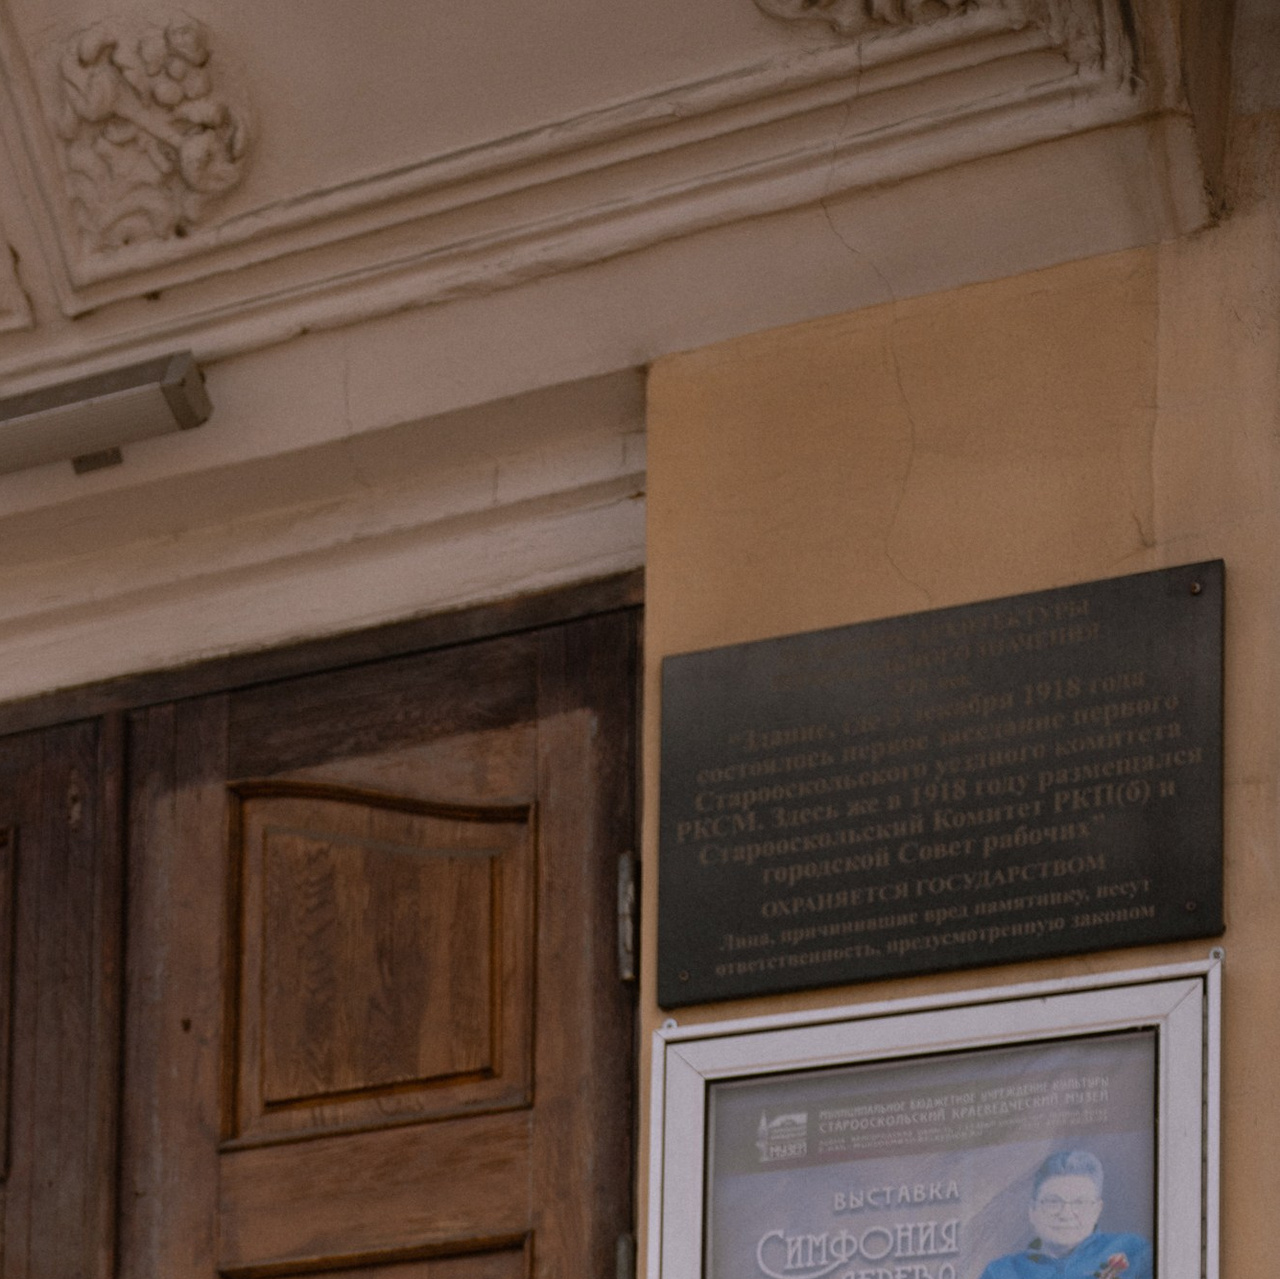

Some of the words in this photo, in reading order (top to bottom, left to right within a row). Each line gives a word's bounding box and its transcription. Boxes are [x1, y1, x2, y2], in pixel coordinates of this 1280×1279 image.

[915, 691, 1014, 724] декабря
[1023, 674, 1082, 706] 1918
[1089, 670, 1146, 696] года
[693, 762, 928, 813] Старооскольского
[934, 742, 1046, 783] уездного
[1055, 721, 1182, 758] комитета
[695, 750, 835, 787] состоялось
[841, 734, 930, 765] первое
[937, 712, 1066, 748] заседание
[1073, 693, 1180, 728] первого
[675, 810, 765, 845] РКСМ.
[771, 804, 840, 830] Здесь
[846, 795, 881, 818] же
[886, 793, 902, 811] в
[911, 777, 968, 808] 1918
[975, 771, 1030, 799] году
[1038, 746, 1204, 794] размещался
[697, 812, 925, 867] Старооскольский
[932, 799, 1044, 833] Комитет
[1053, 778, 1152, 814] РКП(б)
[1158, 779, 1177, 799] и
[760, 879, 910, 919] ОХРАНЯЕТСЯ
[915, 852, 1108, 897] ГОСУДАРСТВОМ
[761, 845, 890, 888] городской
[896, 837, 977, 866] Совет
[714, 943, 882, 977] ответственность,
[885, 916, 1066, 958] предусмотренную
[1070, 903, 1157, 930] законом
[780, 911, 919, 945] причинившие
[923, 903, 969, 926] вред
[974, 888, 1091, 917] памятнику,
[1096, 877, 1153, 900] несут
[819, 1107, 946, 1133] СТАРООСКОЛЬСКИЙ
[951, 1091, 1060, 1120] КРАЕВЕДЧЕСКИЙ
[833, 1179, 960, 1212] ВЫСТАВКА
